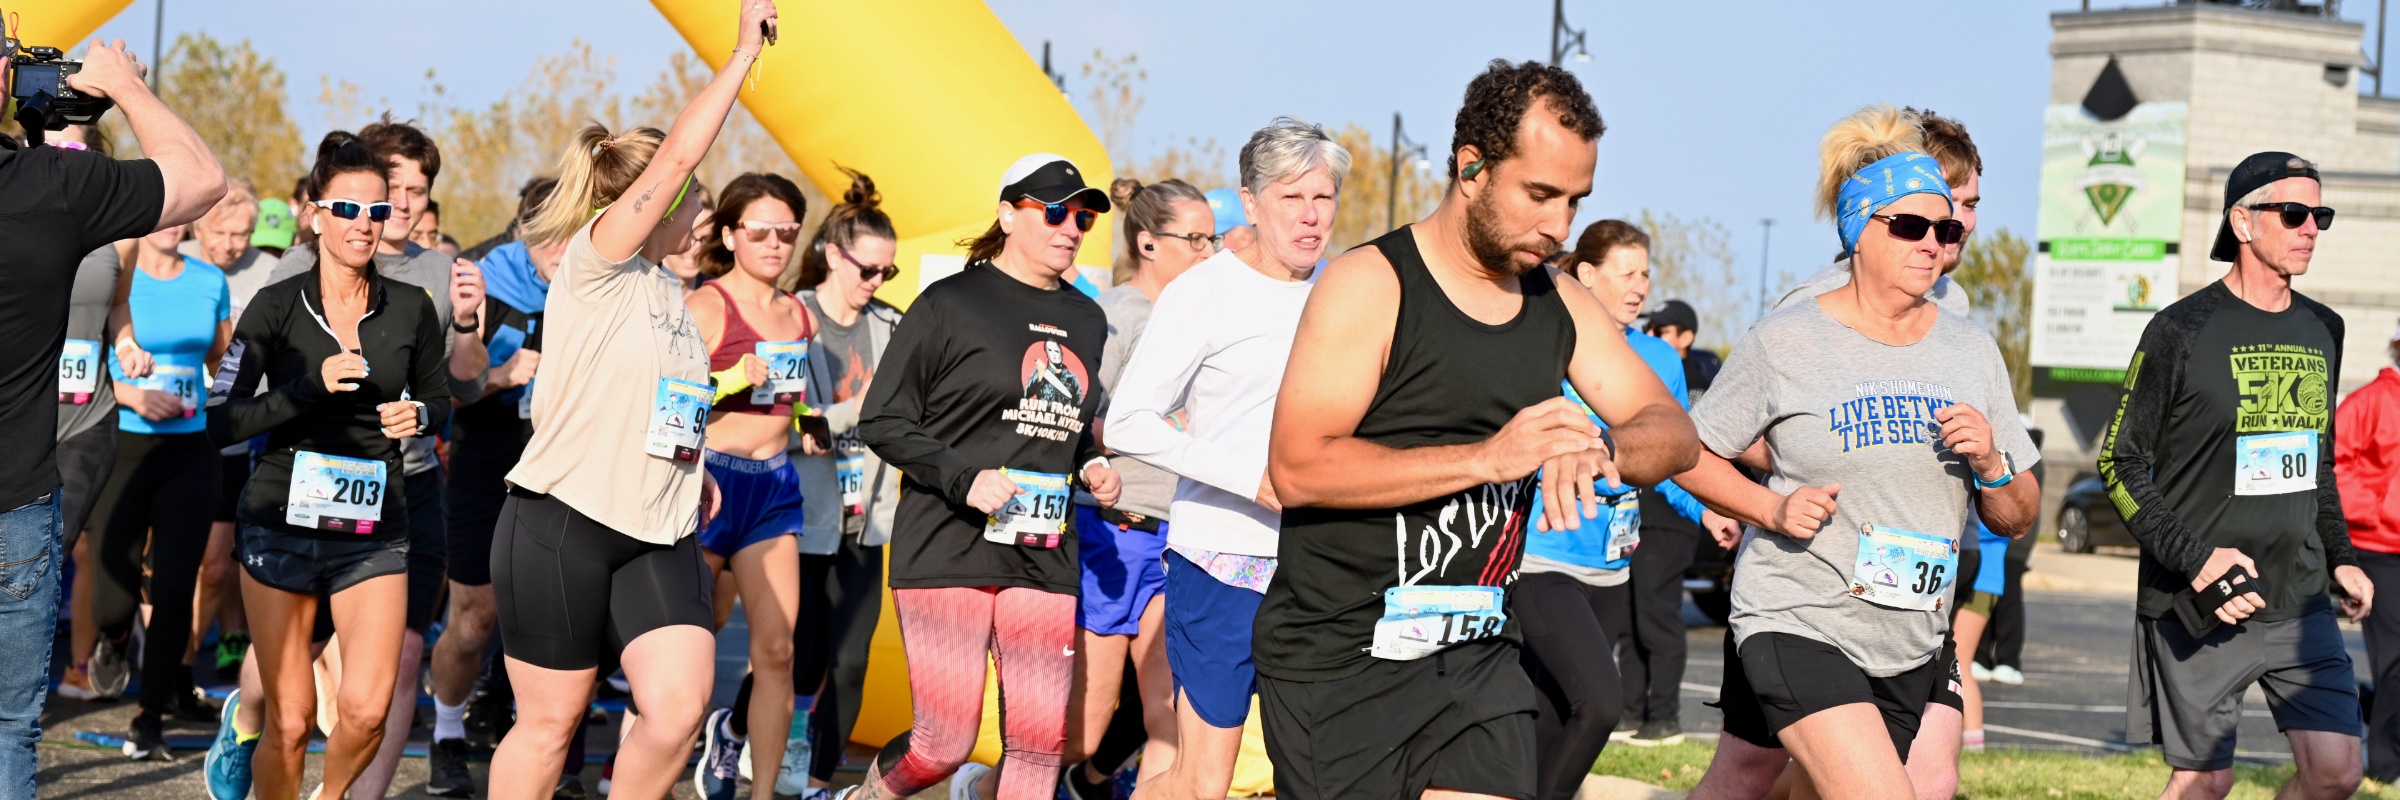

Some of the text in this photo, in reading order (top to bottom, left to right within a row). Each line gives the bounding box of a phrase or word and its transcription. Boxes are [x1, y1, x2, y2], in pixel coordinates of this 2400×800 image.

[2274, 344, 2307, 353] ANNUAL
[62, 358, 87, 380] 59
[2233, 356, 2326, 373] VETERANS
[174, 379, 193, 398] 39
[1889, 380, 1924, 396] HOME
[1925, 382, 1953, 400] RUN
[2237, 371, 2299, 414] 5K
[1001, 409, 1085, 434] MICHAEL MYERS
[1020, 398, 1081, 420] RUN FROM
[1829, 395, 1955, 432] LIVE BETW
[2241, 415, 2325, 430] RUN WALK
[1838, 420, 1926, 453] THE SEC
[730, 457, 762, 474] UNDER
[2282, 452, 2307, 479] 80
[332, 477, 381, 506] 203
[1030, 494, 1066, 520] 153
[1912, 561, 1945, 595] 36
[1436, 614, 1501, 646] 158
